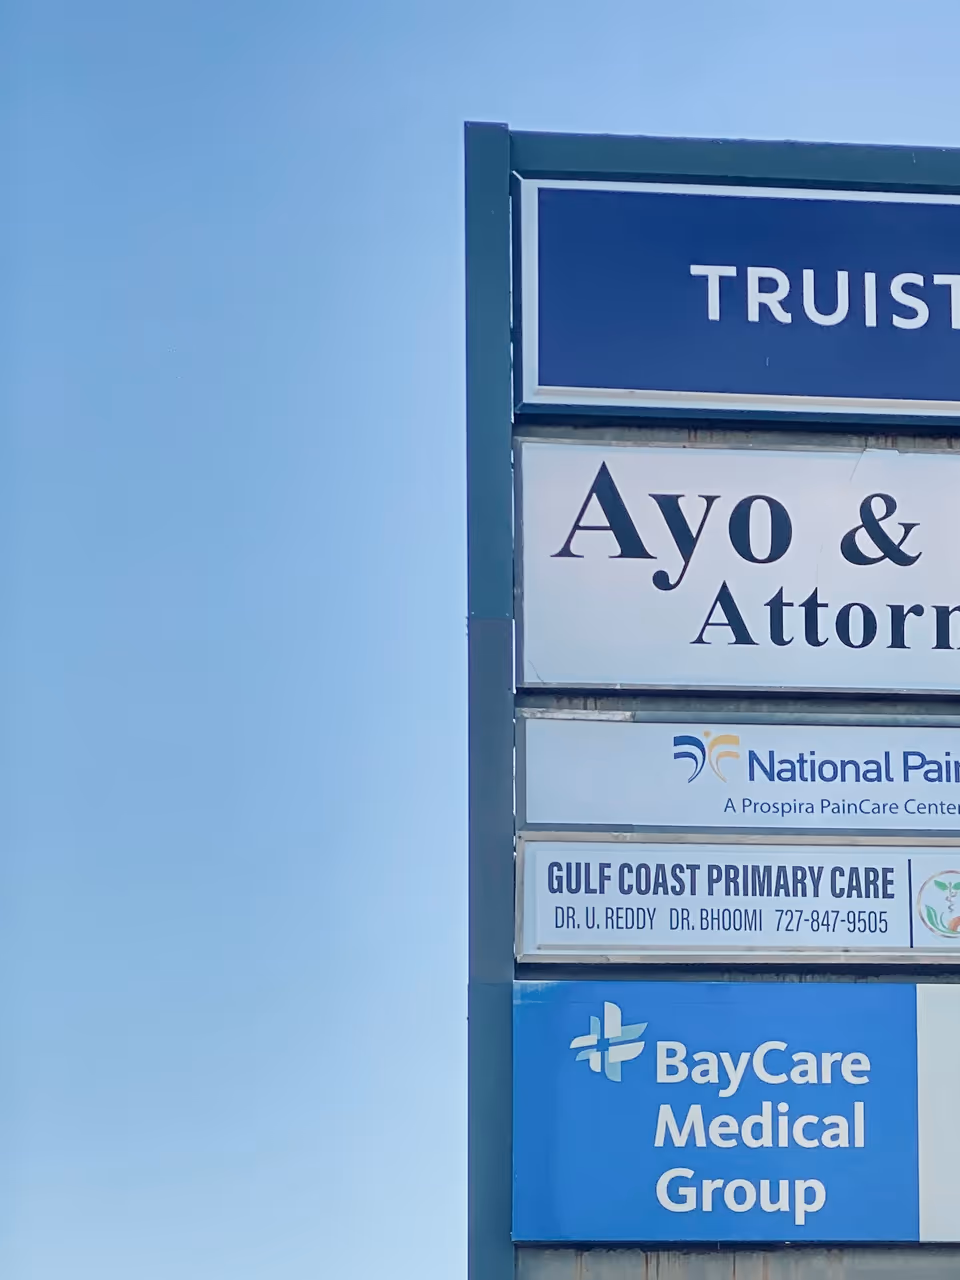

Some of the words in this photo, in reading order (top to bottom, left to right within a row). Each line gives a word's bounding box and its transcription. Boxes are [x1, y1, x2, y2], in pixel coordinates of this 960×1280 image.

[550, 461, 792, 591] Ayo
[841, 493, 920, 566] &
[749, 750, 894, 782] National
[724, 798, 736, 813] A
[743, 798, 814, 817] Prospira
[821, 799, 898, 815] PainCare
[548, 862, 611, 894] GULF
[619, 863, 700, 895] COAST
[708, 865, 824, 898] PRIMARY
[831, 866, 894, 899] CARE
[555, 906, 580, 929] DR.
[586, 907, 599, 929] U.
[605, 907, 656, 930] REDDY
[669, 908, 694, 931] DR.
[701, 909, 762, 931] BHOOMI
[775, 910, 888, 933] 727-847-9505
[657, 1040, 870, 1097] BayCare
[654, 1101, 864, 1149] Medical
[655, 1168, 826, 1226] Group
